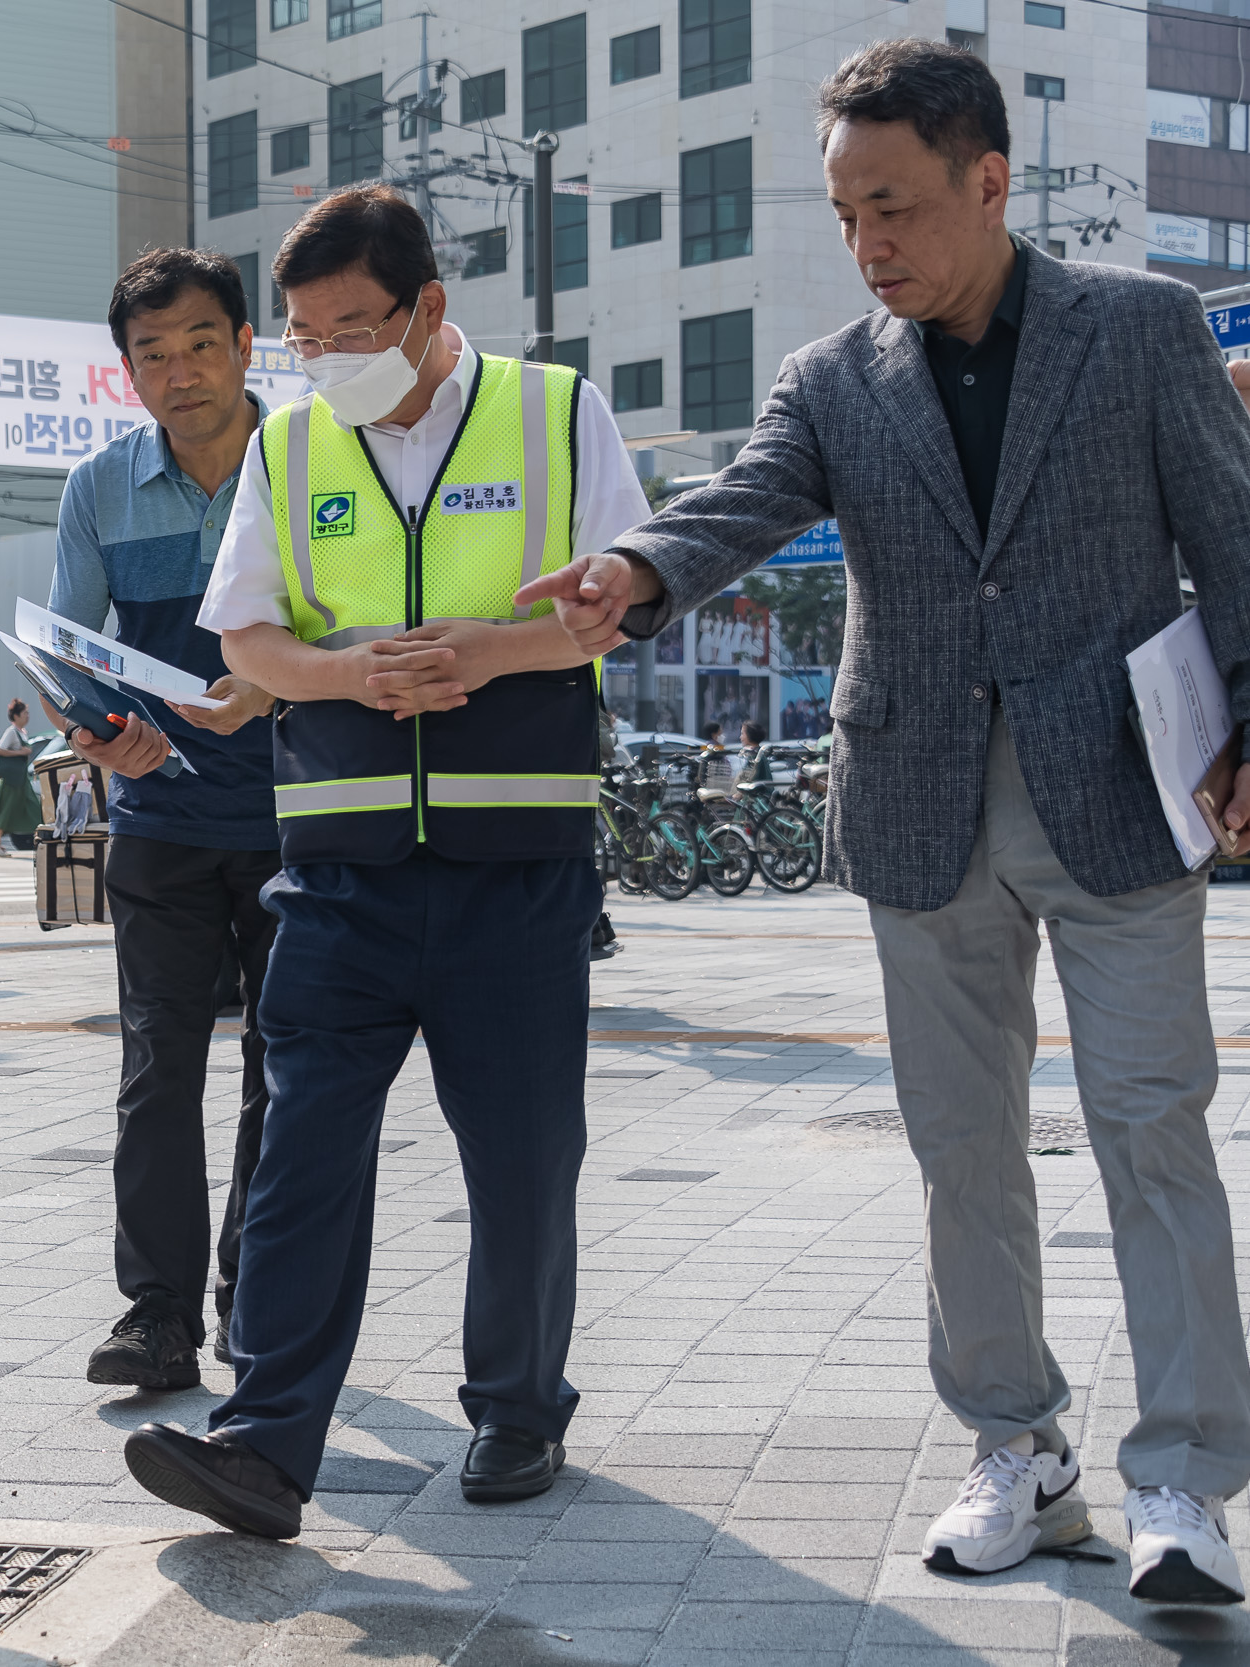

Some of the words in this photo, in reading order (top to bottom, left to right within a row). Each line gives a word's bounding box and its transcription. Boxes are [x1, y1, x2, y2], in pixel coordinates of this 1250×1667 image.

[464, 497, 516, 510] 광진구청장
[315, 522, 349, 534] 광진구
[803, 519, 840, 540] 산로
[778, 541, 841, 557] Achasan-ro
